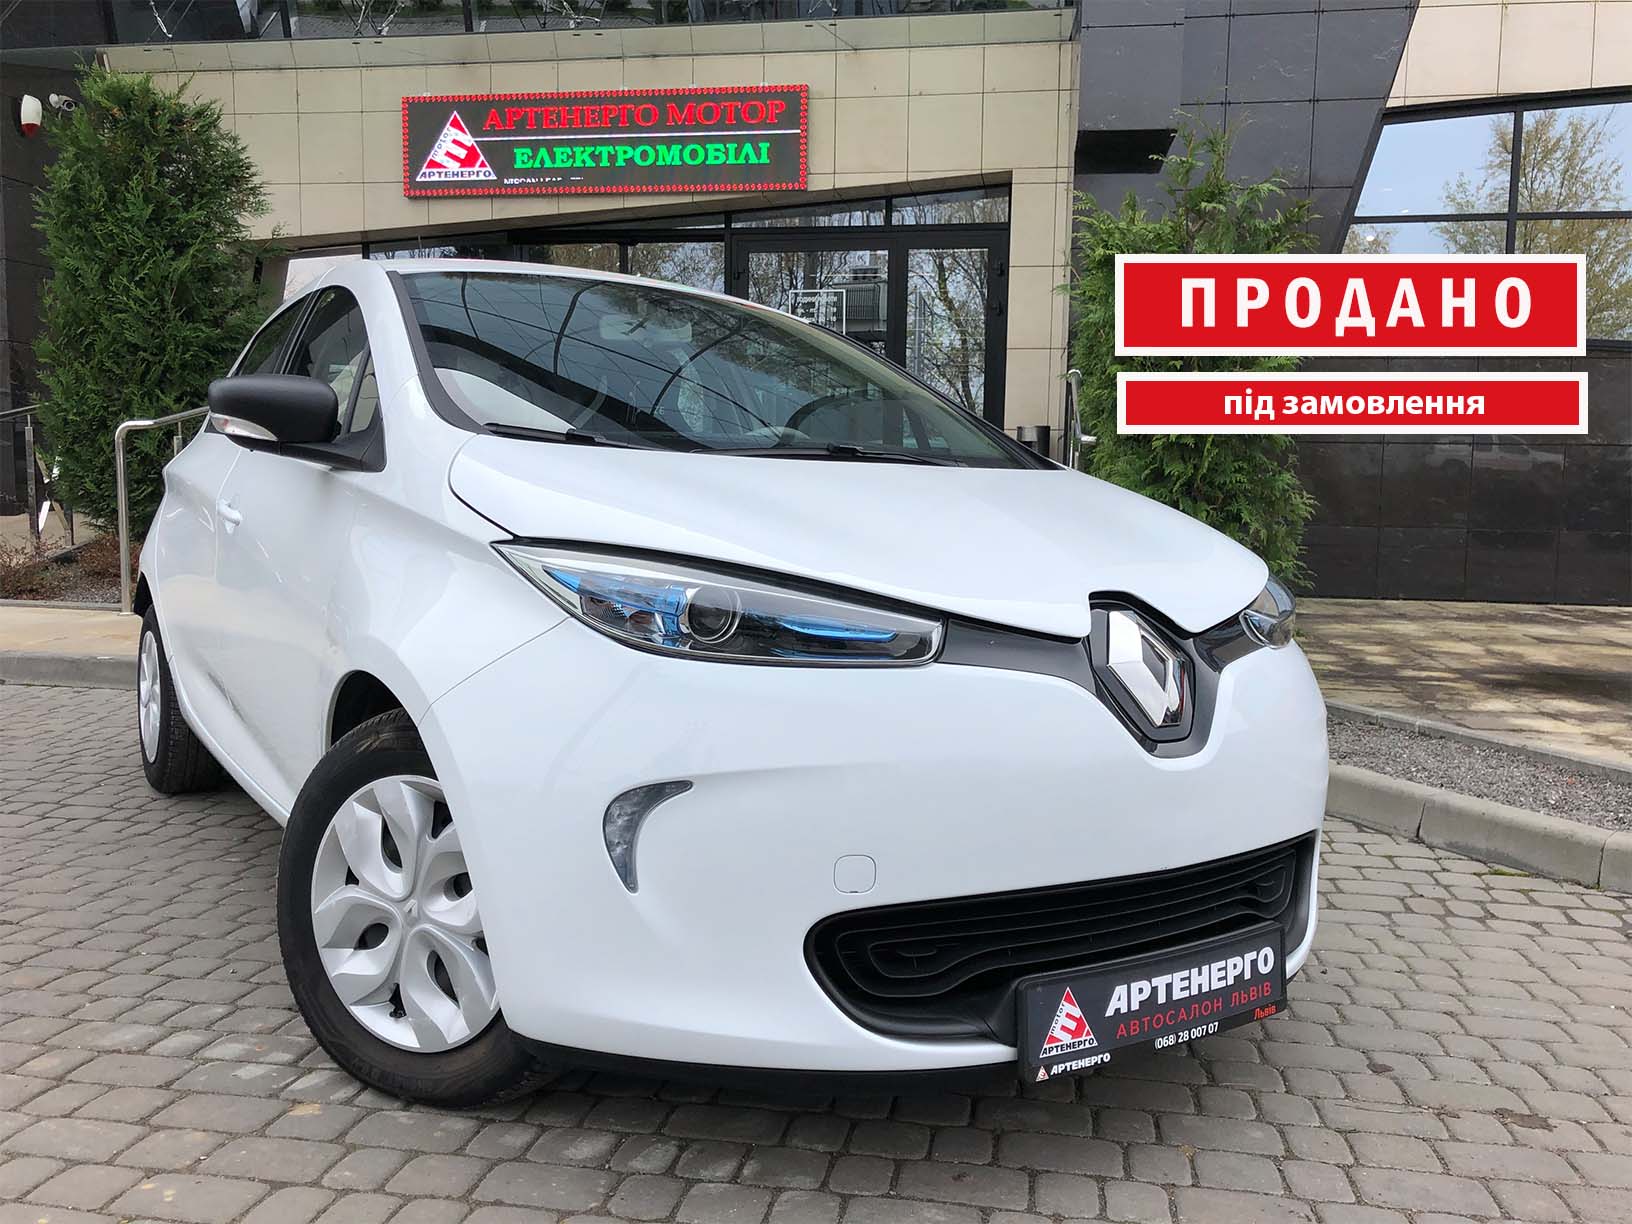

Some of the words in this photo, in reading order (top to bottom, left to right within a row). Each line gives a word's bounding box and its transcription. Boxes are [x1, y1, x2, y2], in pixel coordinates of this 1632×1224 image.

[482, 103, 659, 130] АРТЕНЕРГО
[666, 100, 786, 126] МОТОР
[513, 141, 770, 169] ЕЛЕКТРОМОБІЛІ
[419, 169, 492, 179] АРТЕНЕРГО
[1104, 946, 1275, 1018] АРТЕНЕРГО
[1050, 1002, 1065, 1035] motor
[1115, 996, 1224, 1040] АВТОСАЛОН
[1230, 981, 1272, 1008] ЛЬВІВ
[1253, 1004, 1277, 1020] Львів
[1041, 1038, 1095, 1057] АРТЕНЕРГО
[1154, 1034, 1177, 1050] (068)
[1178, 1030, 1189, 1044] 28
[1050, 1053, 1111, 1076] АРТЕНЕРГО
